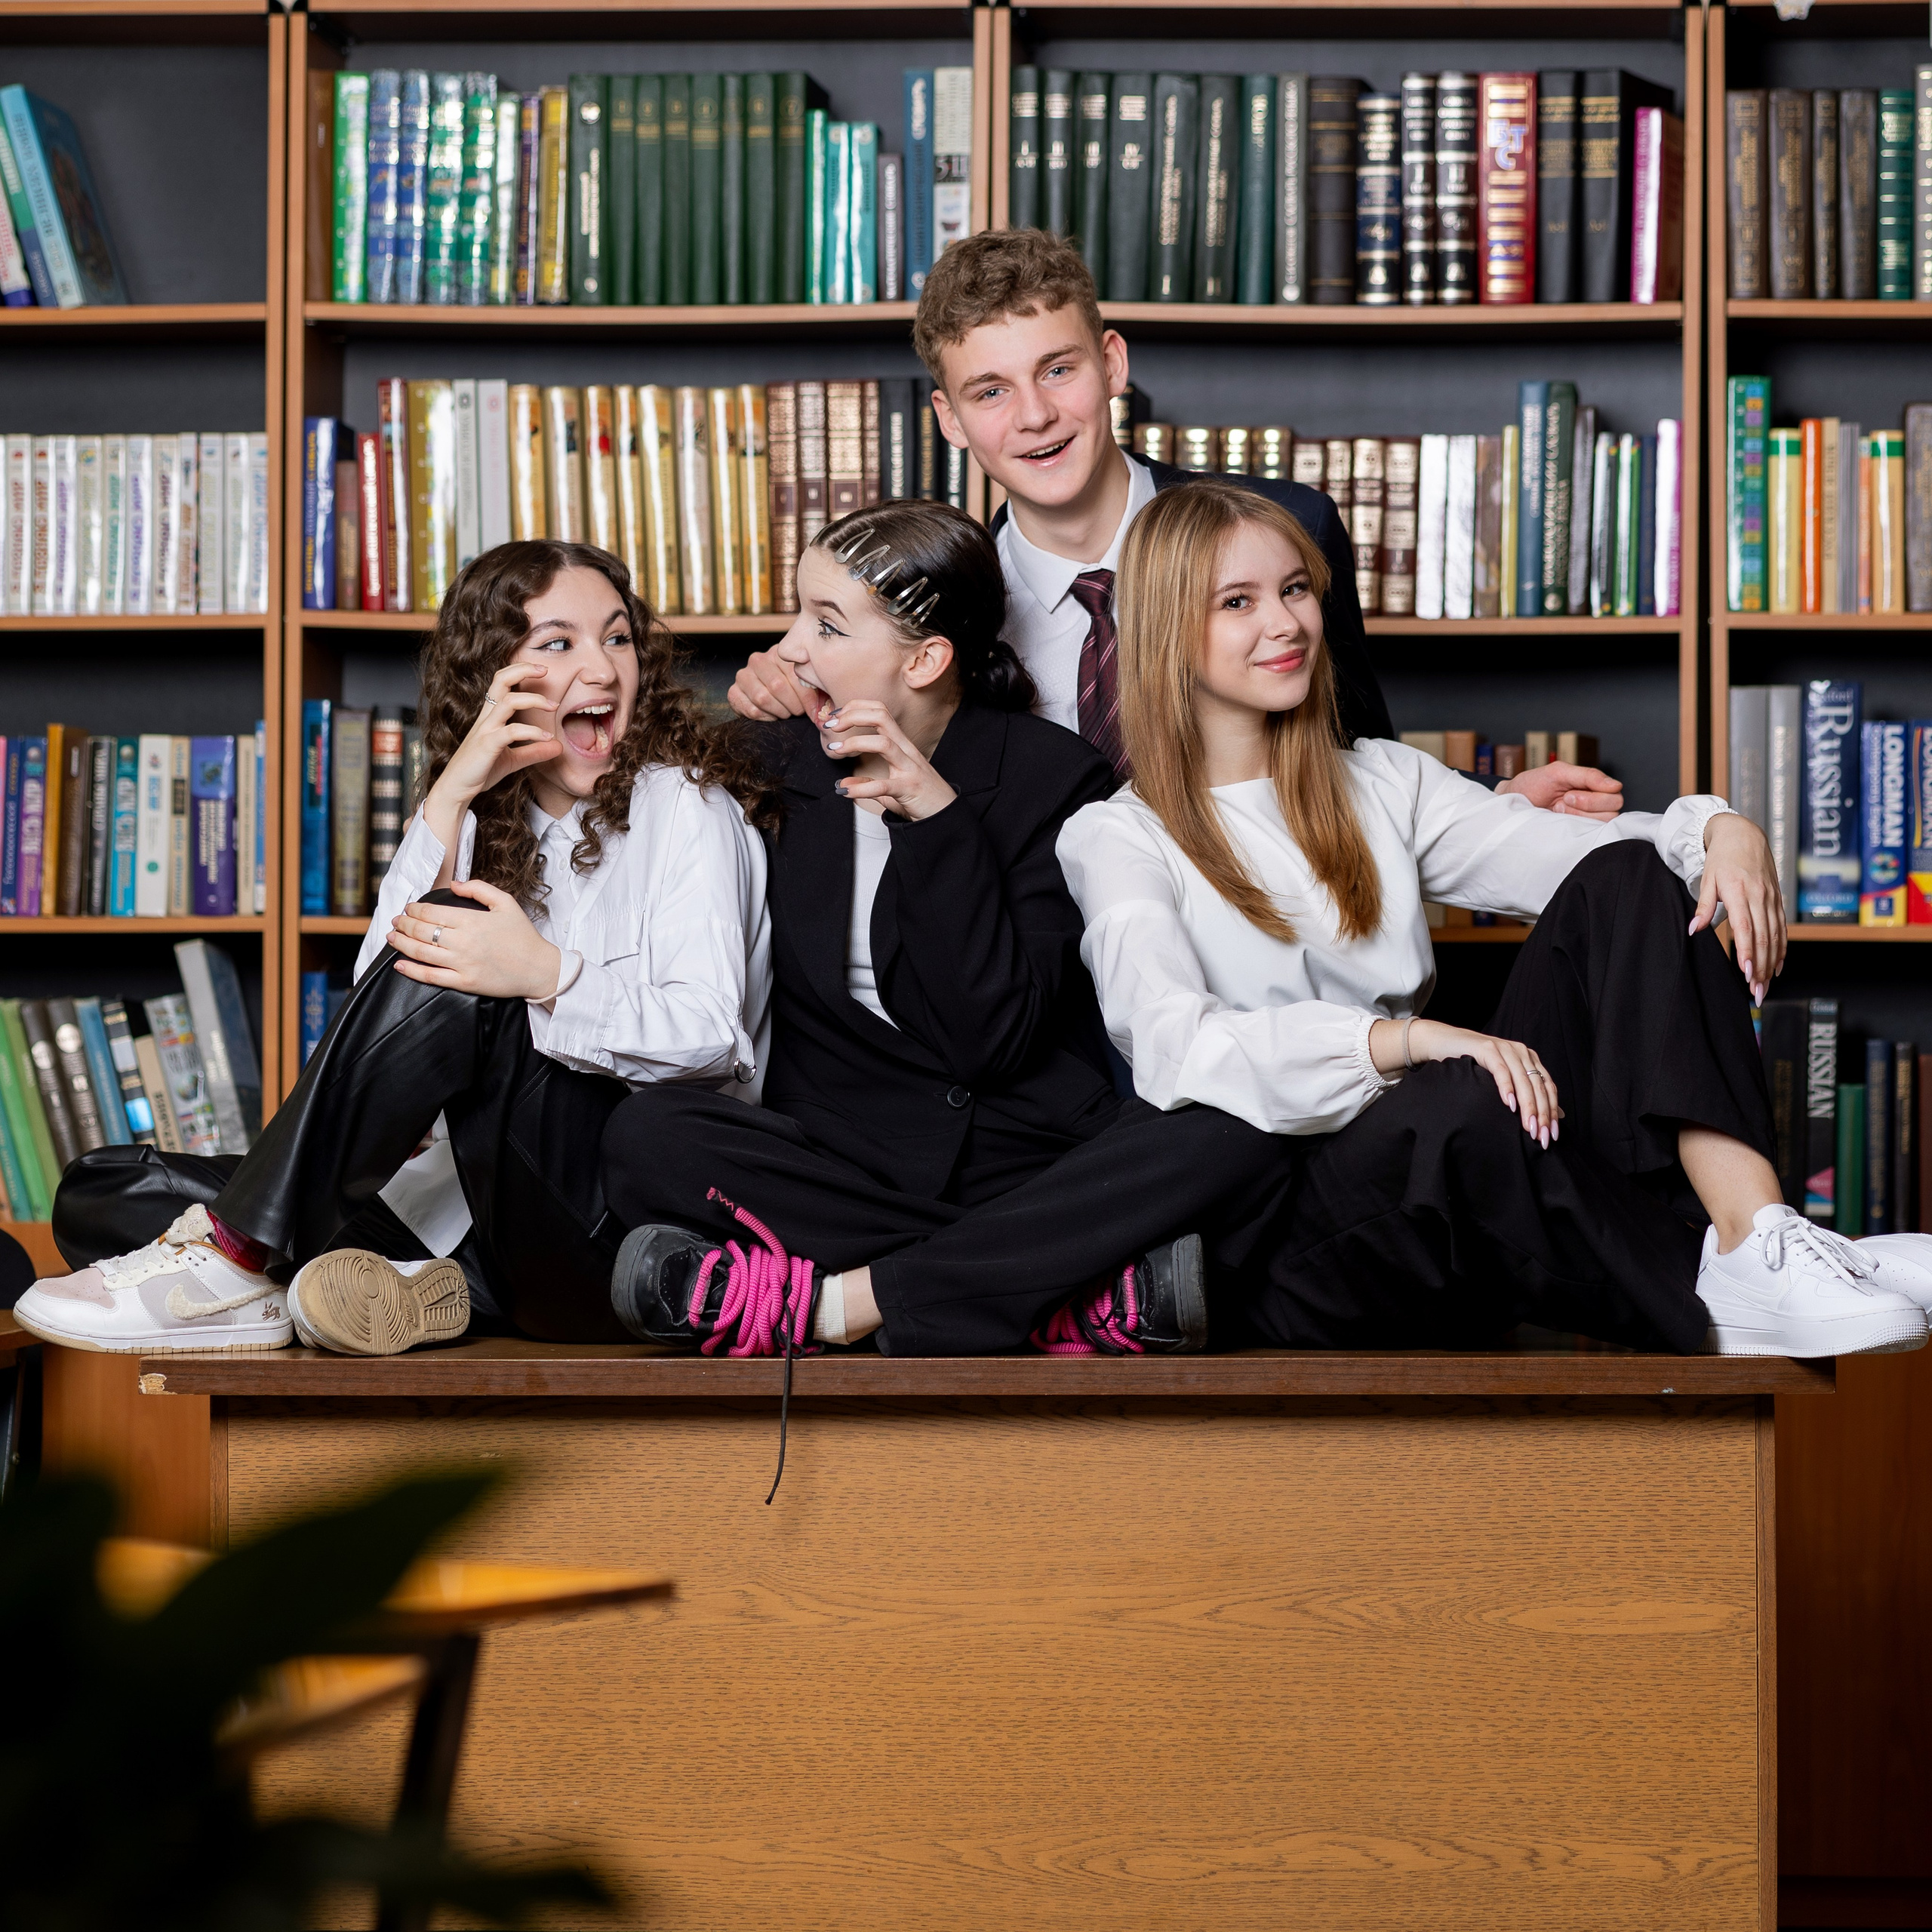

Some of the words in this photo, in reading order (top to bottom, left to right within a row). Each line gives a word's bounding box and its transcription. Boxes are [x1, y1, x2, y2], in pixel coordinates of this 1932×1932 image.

[1810, 703, 1854, 857] Russian
[1882, 724, 1904, 848] LONGMAN
[1807, 1021, 1838, 1120] RUSSIAN
